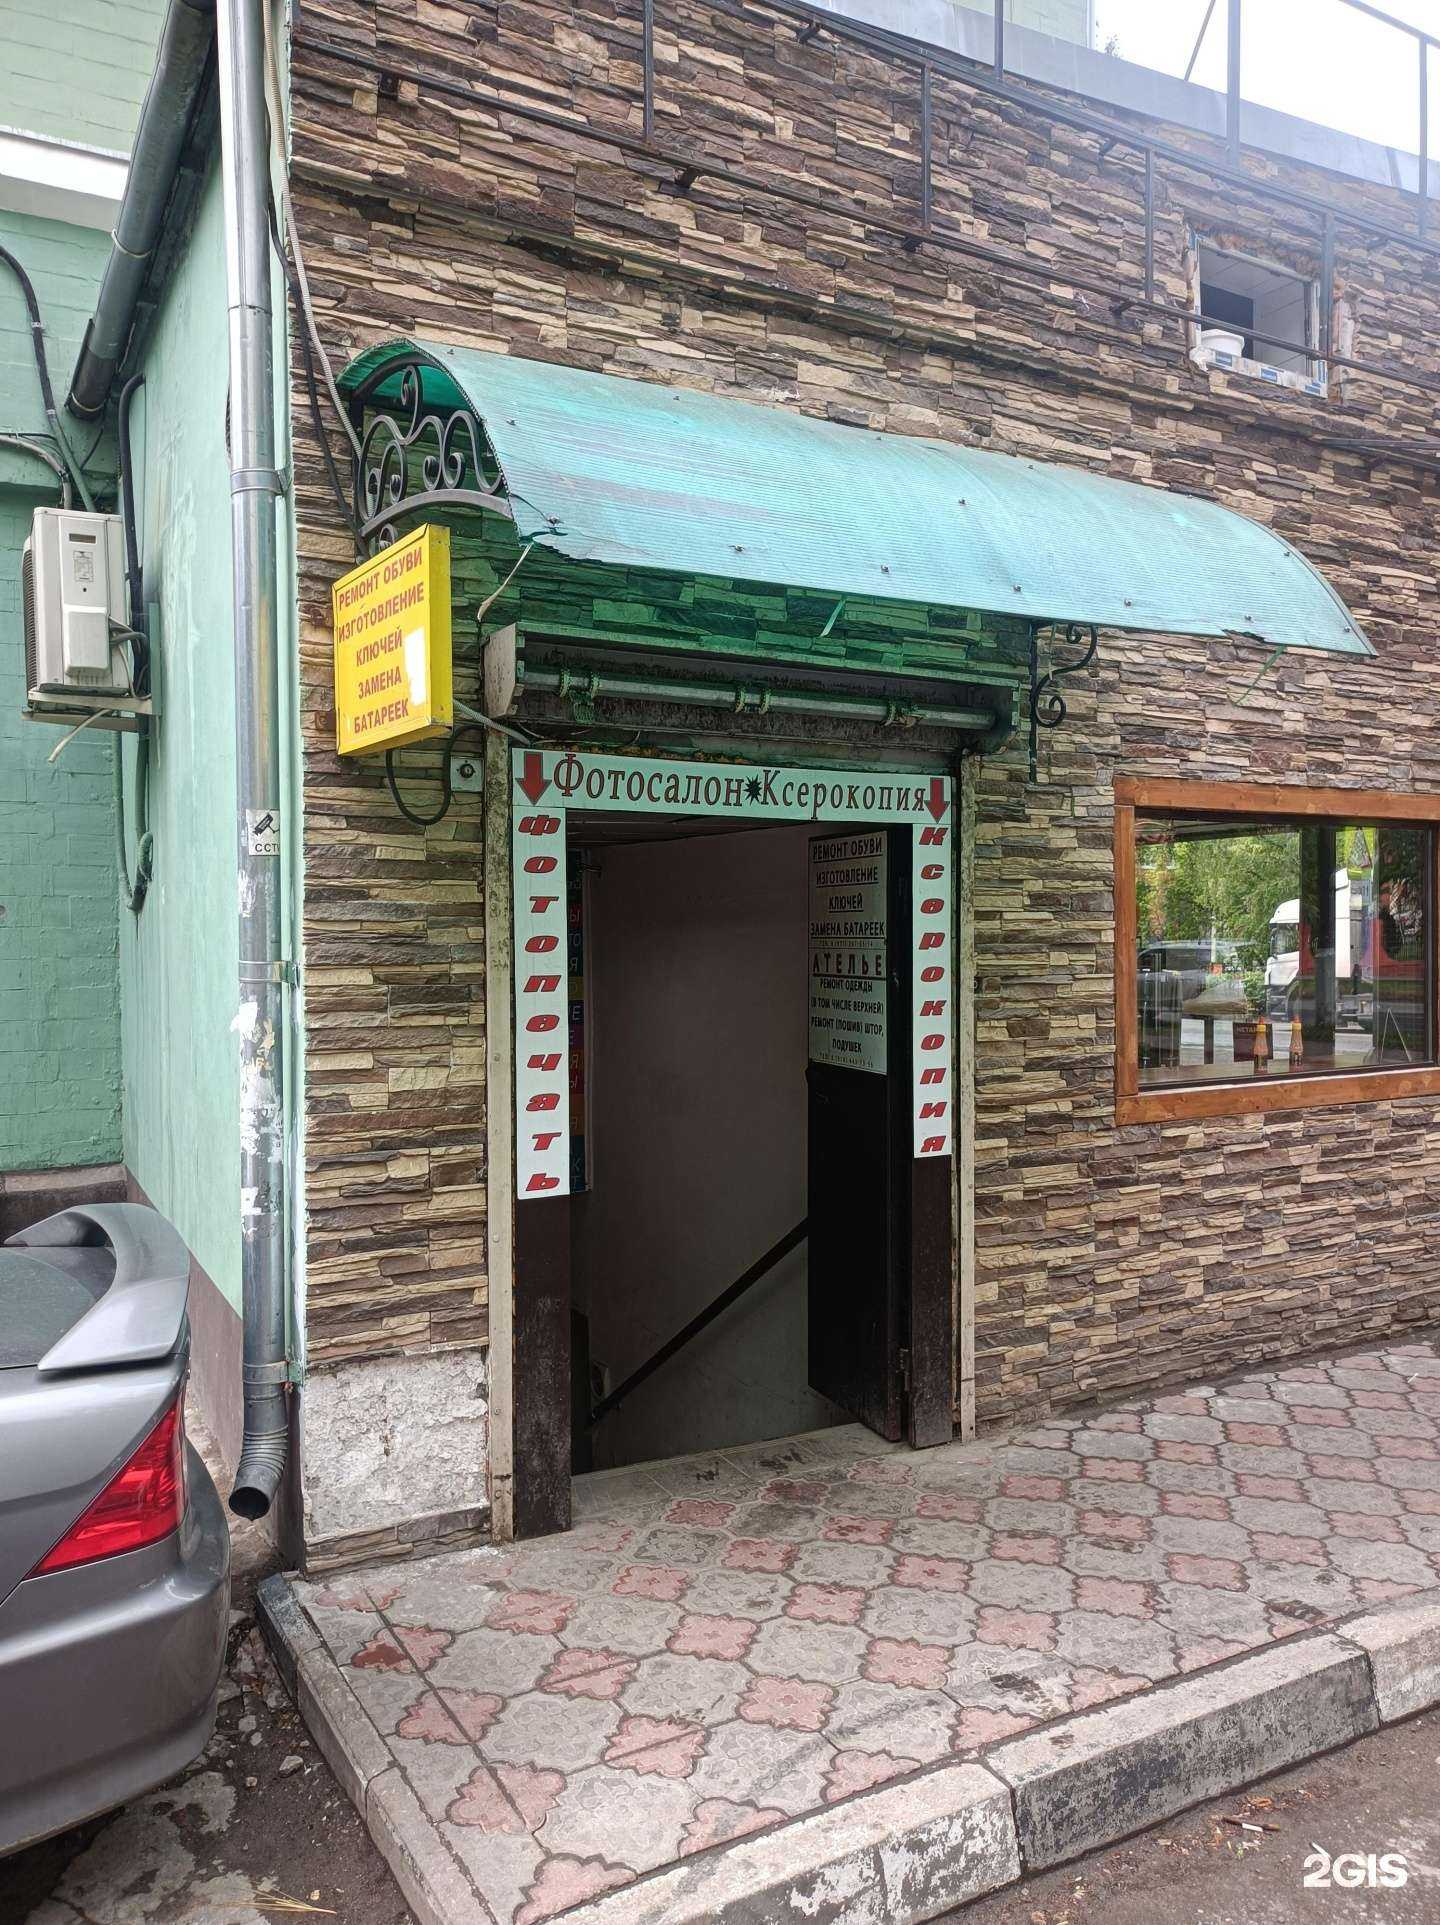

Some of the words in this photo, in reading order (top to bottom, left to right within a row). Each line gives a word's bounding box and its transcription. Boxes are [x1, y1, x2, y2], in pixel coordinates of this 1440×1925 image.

[338, 571, 380, 611] РЕМОНТ
[383, 546, 423, 585] ОБУВИ
[338, 581, 425, 644] ИЗГОТОВЛЕНИЕ
[356, 626, 403, 668] КЛЮЧЕЙ
[358, 666, 402, 700] ЗАМЕНА
[353, 698, 409, 734] БАТАРЕЕК
[553, 753, 743, 808] Фотосалон
[761, 769, 927, 820] Ксерокопия
[812, 842, 849, 861] РЕМОНТ
[850, 837, 882, 856] ОБУВИ
[816, 866, 878, 885] ИЗГОТОВЛЕНИЕ
[828, 892, 863, 910] КЛЮЧЕЙ
[810, 921, 842, 936] ЗАМЕНА
[843, 921, 885, 937] БАТАРЕЕК
[812, 952, 883, 976] АТЕЛЬЕ
[820, 978, 844, 990] РЕМОНТ
[845, 979, 873, 993] ОДЕЖДЫ
[817, 997, 830, 1009] ТОМ
[831, 998, 852, 1011] ЧИСЛЕ
[853, 1000, 884, 1014] ВЕРХНЕЙ)
[811, 1016, 834, 1030] РЕМОНТ
[835, 1019, 863, 1034] (ПОШИВ)
[864, 1022, 884, 1038] ШТОР,
[832, 1038, 862, 1054] ПОДУШЕК
